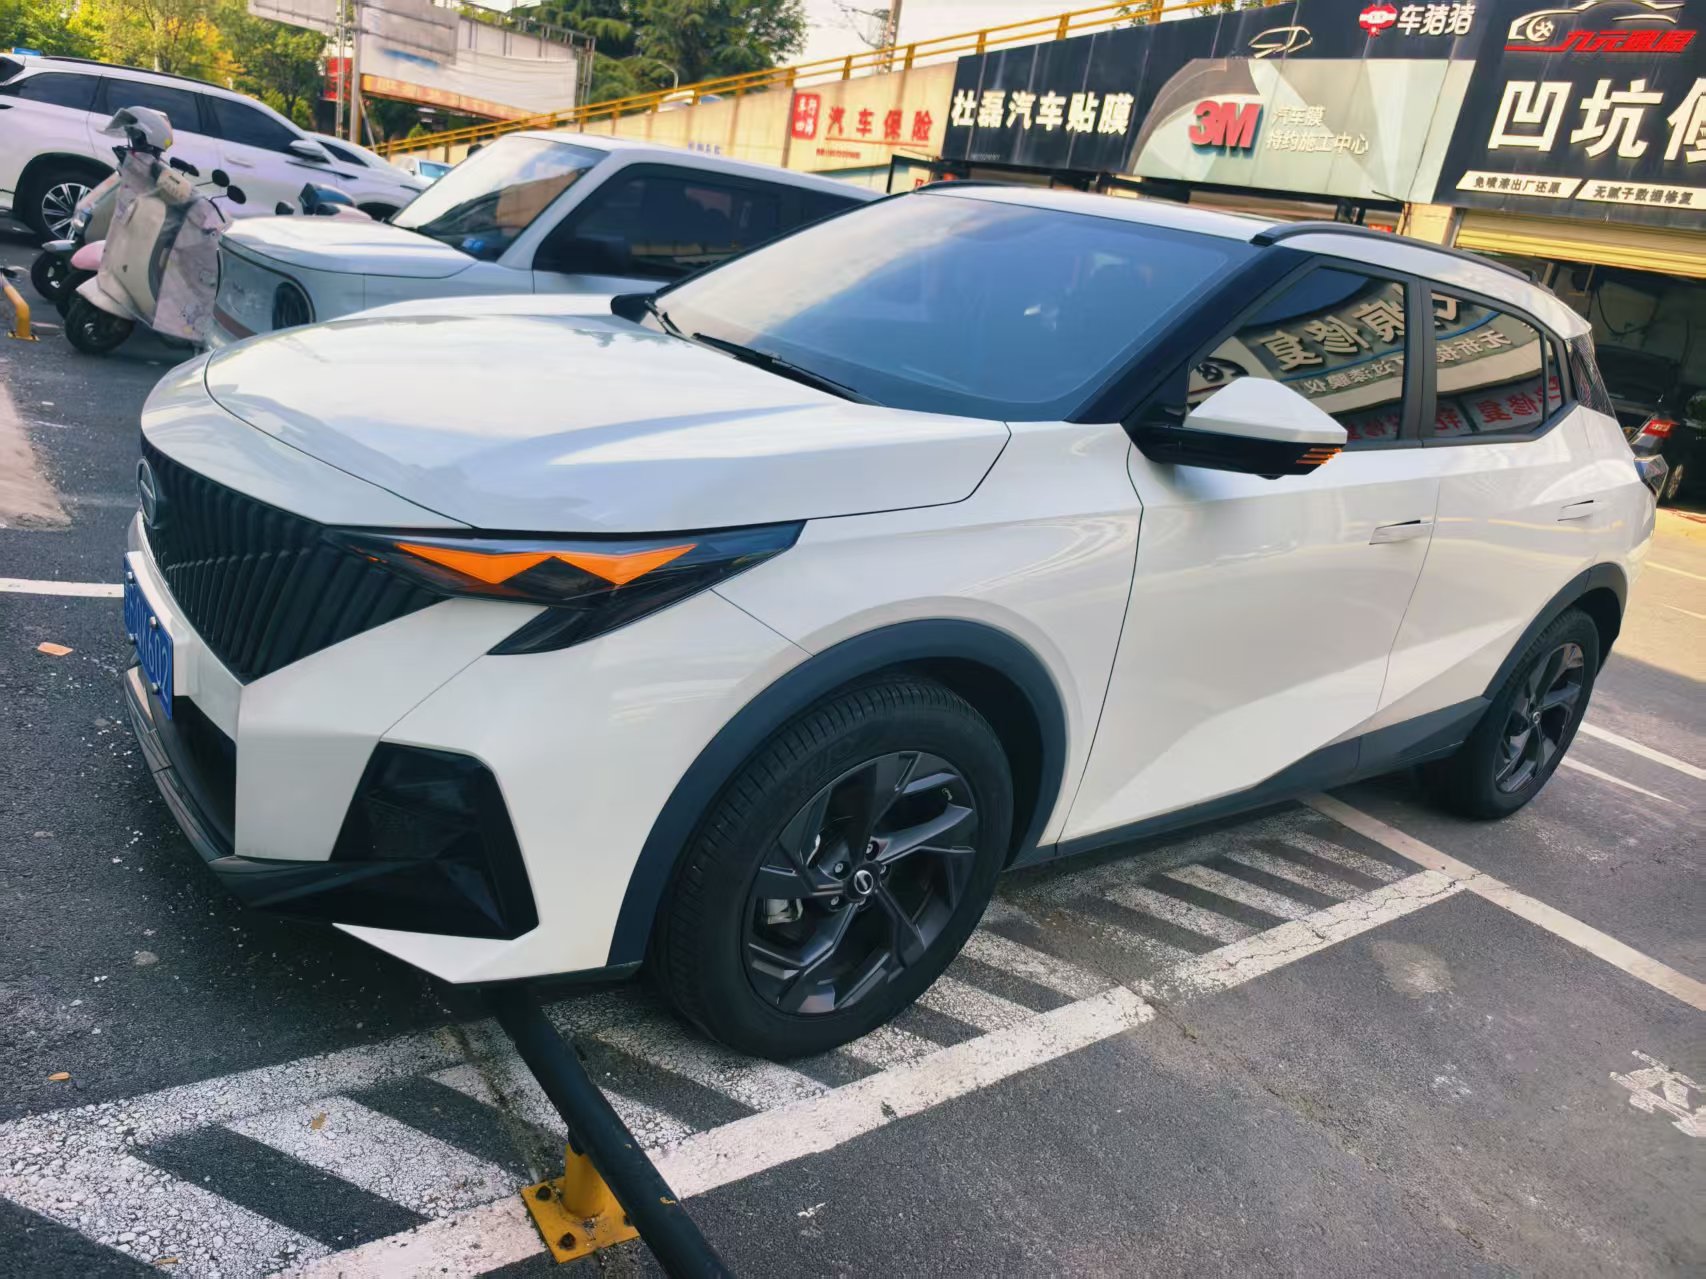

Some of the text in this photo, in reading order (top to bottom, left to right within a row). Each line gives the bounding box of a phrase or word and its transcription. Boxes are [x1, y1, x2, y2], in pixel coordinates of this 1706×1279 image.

[827, 105, 933, 141] 汽车保险
[951, 89, 1135, 136] 杜磊汽车贴膜
[1189, 100, 1262, 148] 3M
[1272, 106, 1326, 127] 汽车膜
[1266, 131, 1368, 155] 特约施工中心
